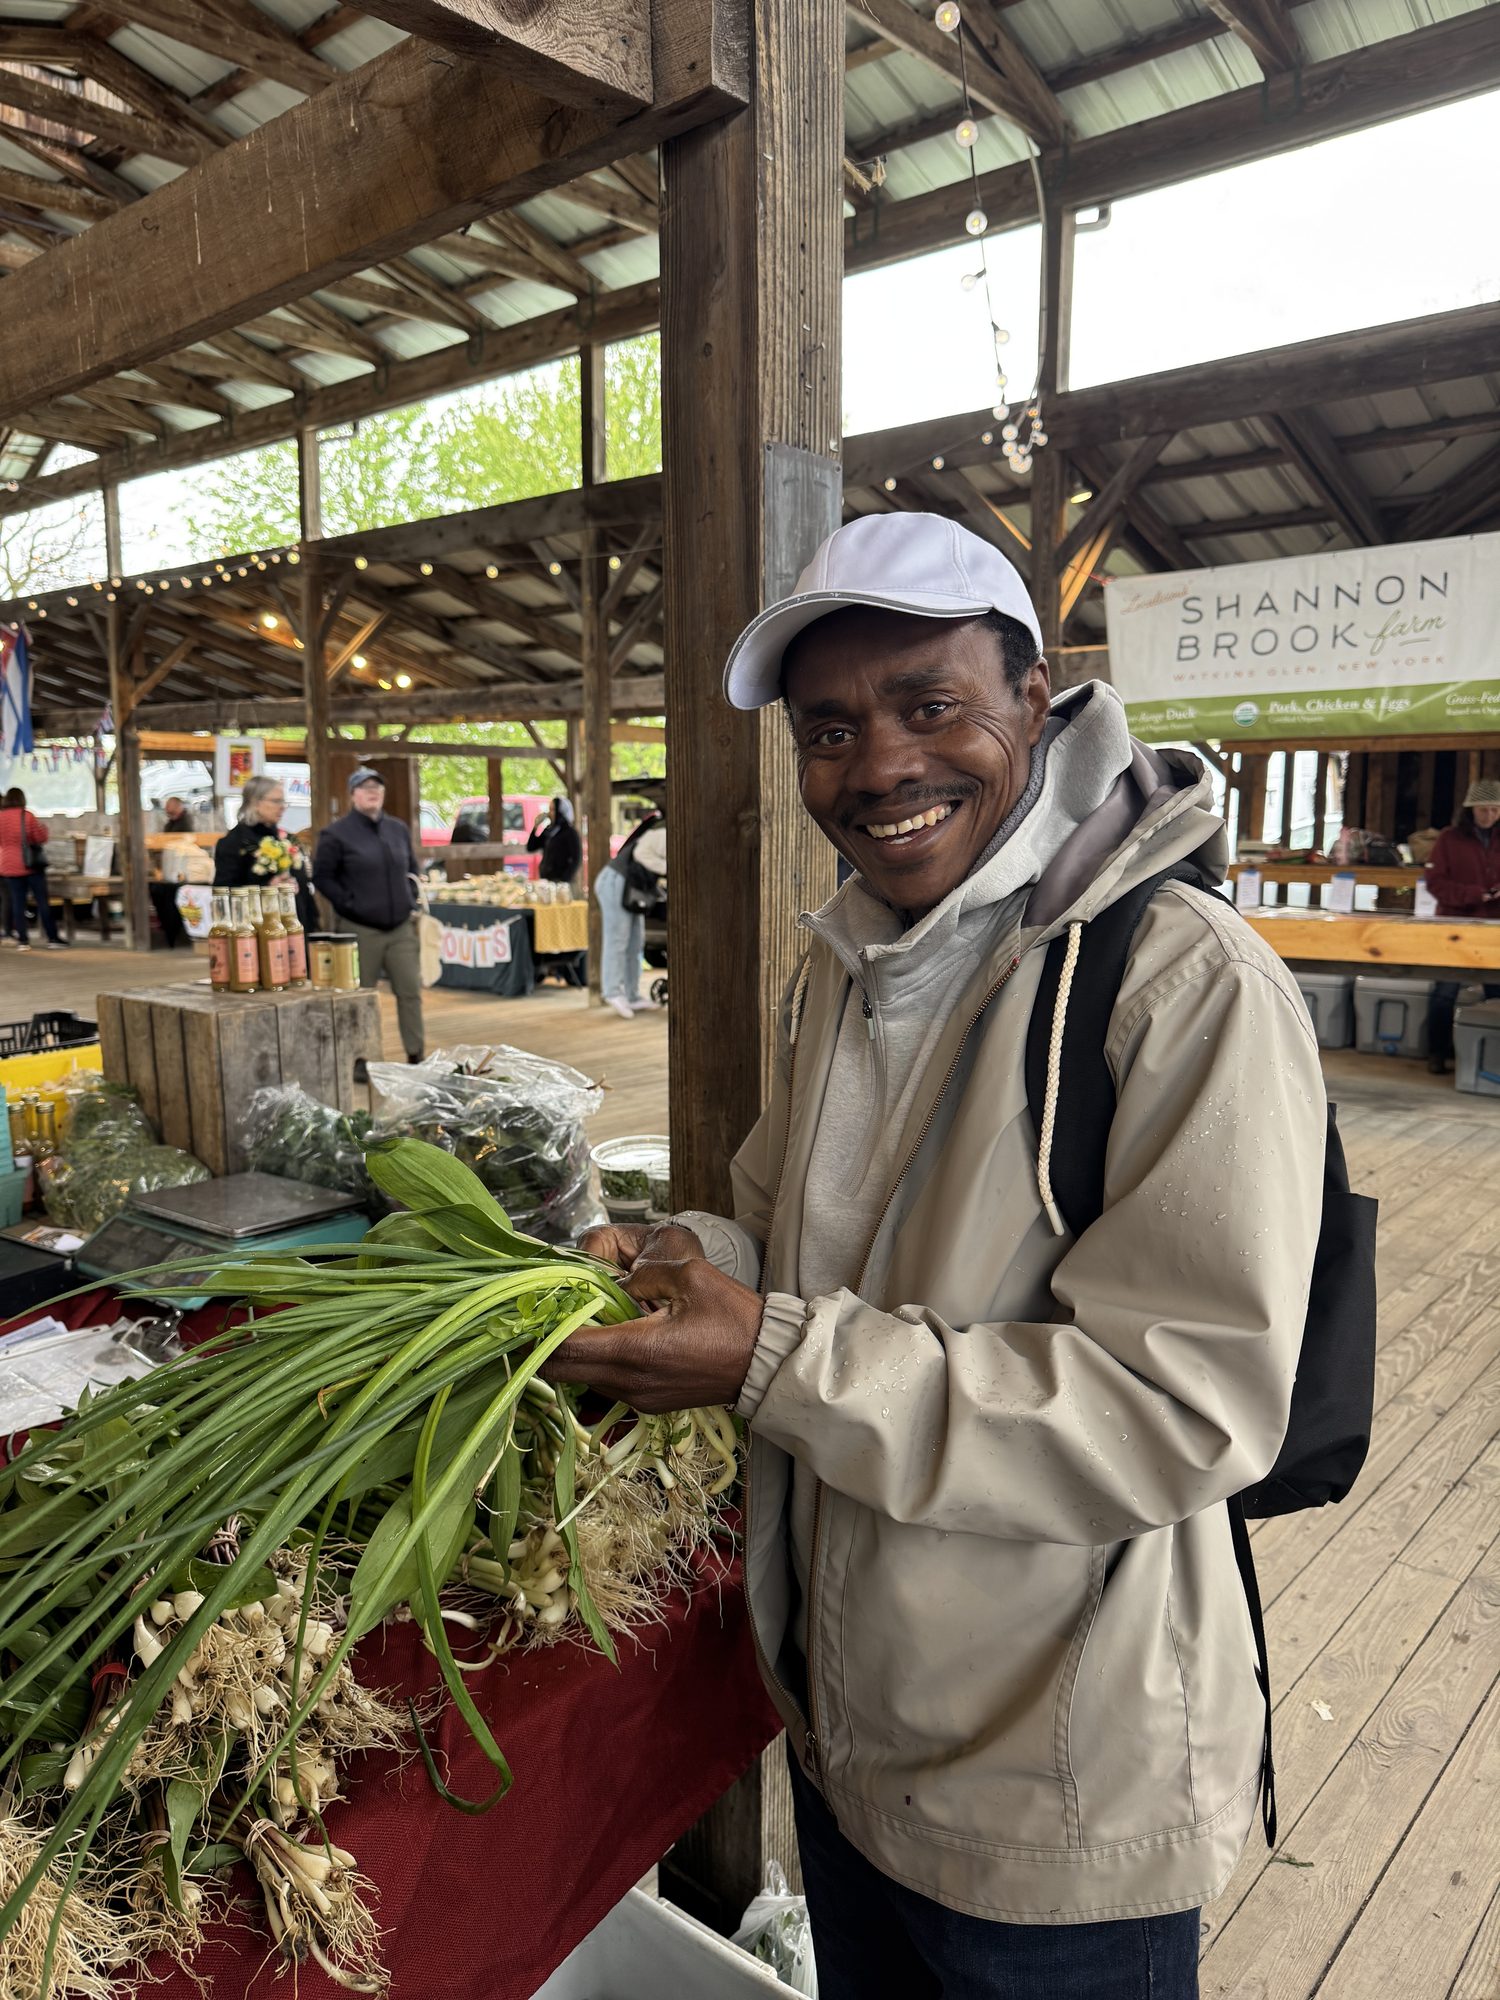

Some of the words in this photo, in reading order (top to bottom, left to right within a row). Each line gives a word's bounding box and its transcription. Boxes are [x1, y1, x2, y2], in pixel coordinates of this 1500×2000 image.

[1181, 571, 1448, 624] SHANNON
[1176, 622, 1359, 662] BROOK
[1363, 608, 1447, 656] farm
[1337, 660, 1378, 672] NEW
[1391, 655, 1445, 667] YORK
[1165, 706, 1196, 720] Duck
[1305, 697, 1361, 712] Chicken
[1362, 697, 1376, 711] &
[1380, 695, 1410, 713] Eggs
